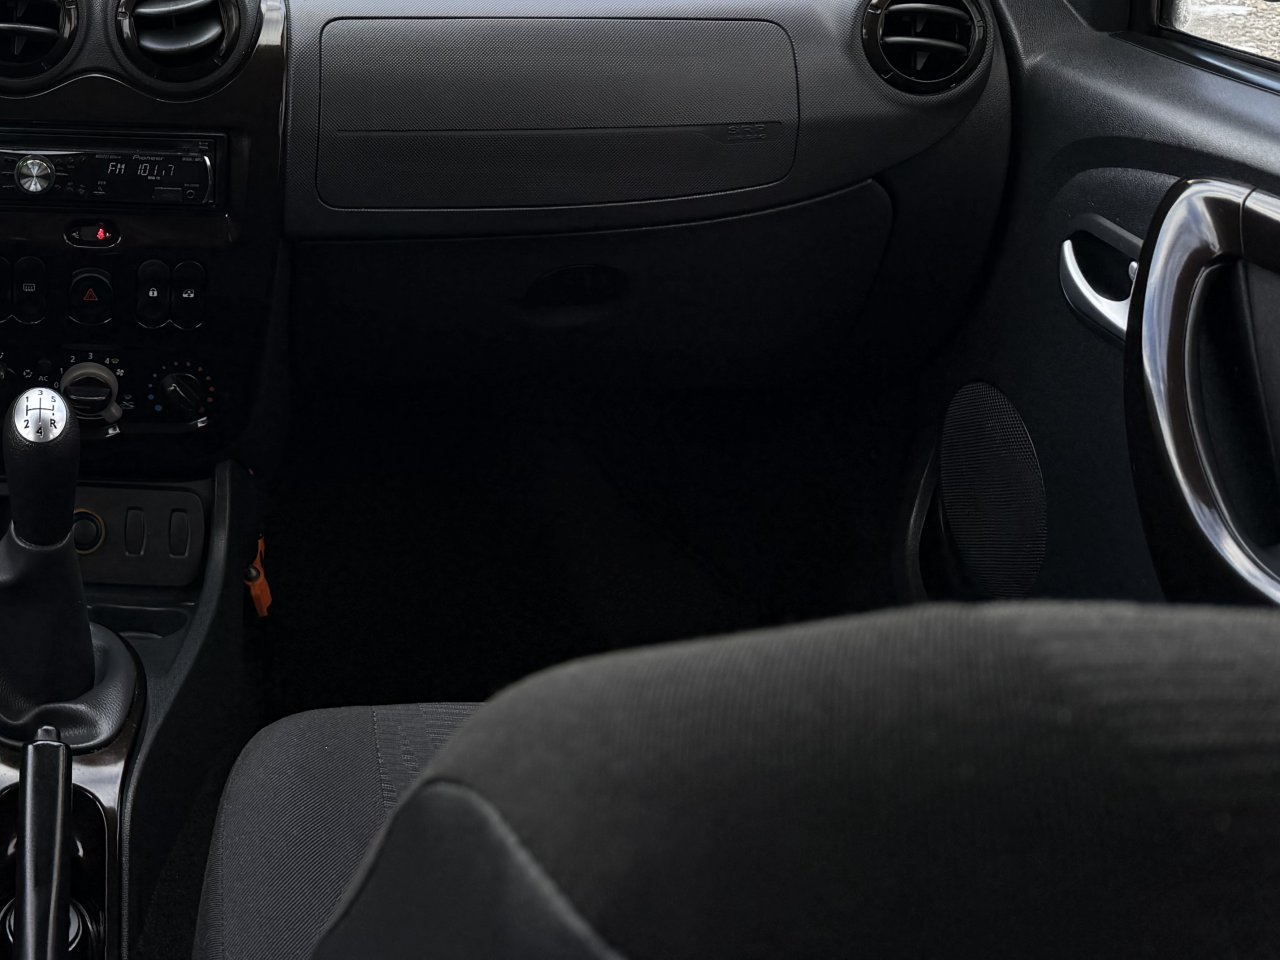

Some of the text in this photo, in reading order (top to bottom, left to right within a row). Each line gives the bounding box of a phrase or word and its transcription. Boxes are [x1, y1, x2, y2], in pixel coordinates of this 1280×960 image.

[107, 162, 125, 175] FM
[23, 419, 58, 438] 2 4 R
